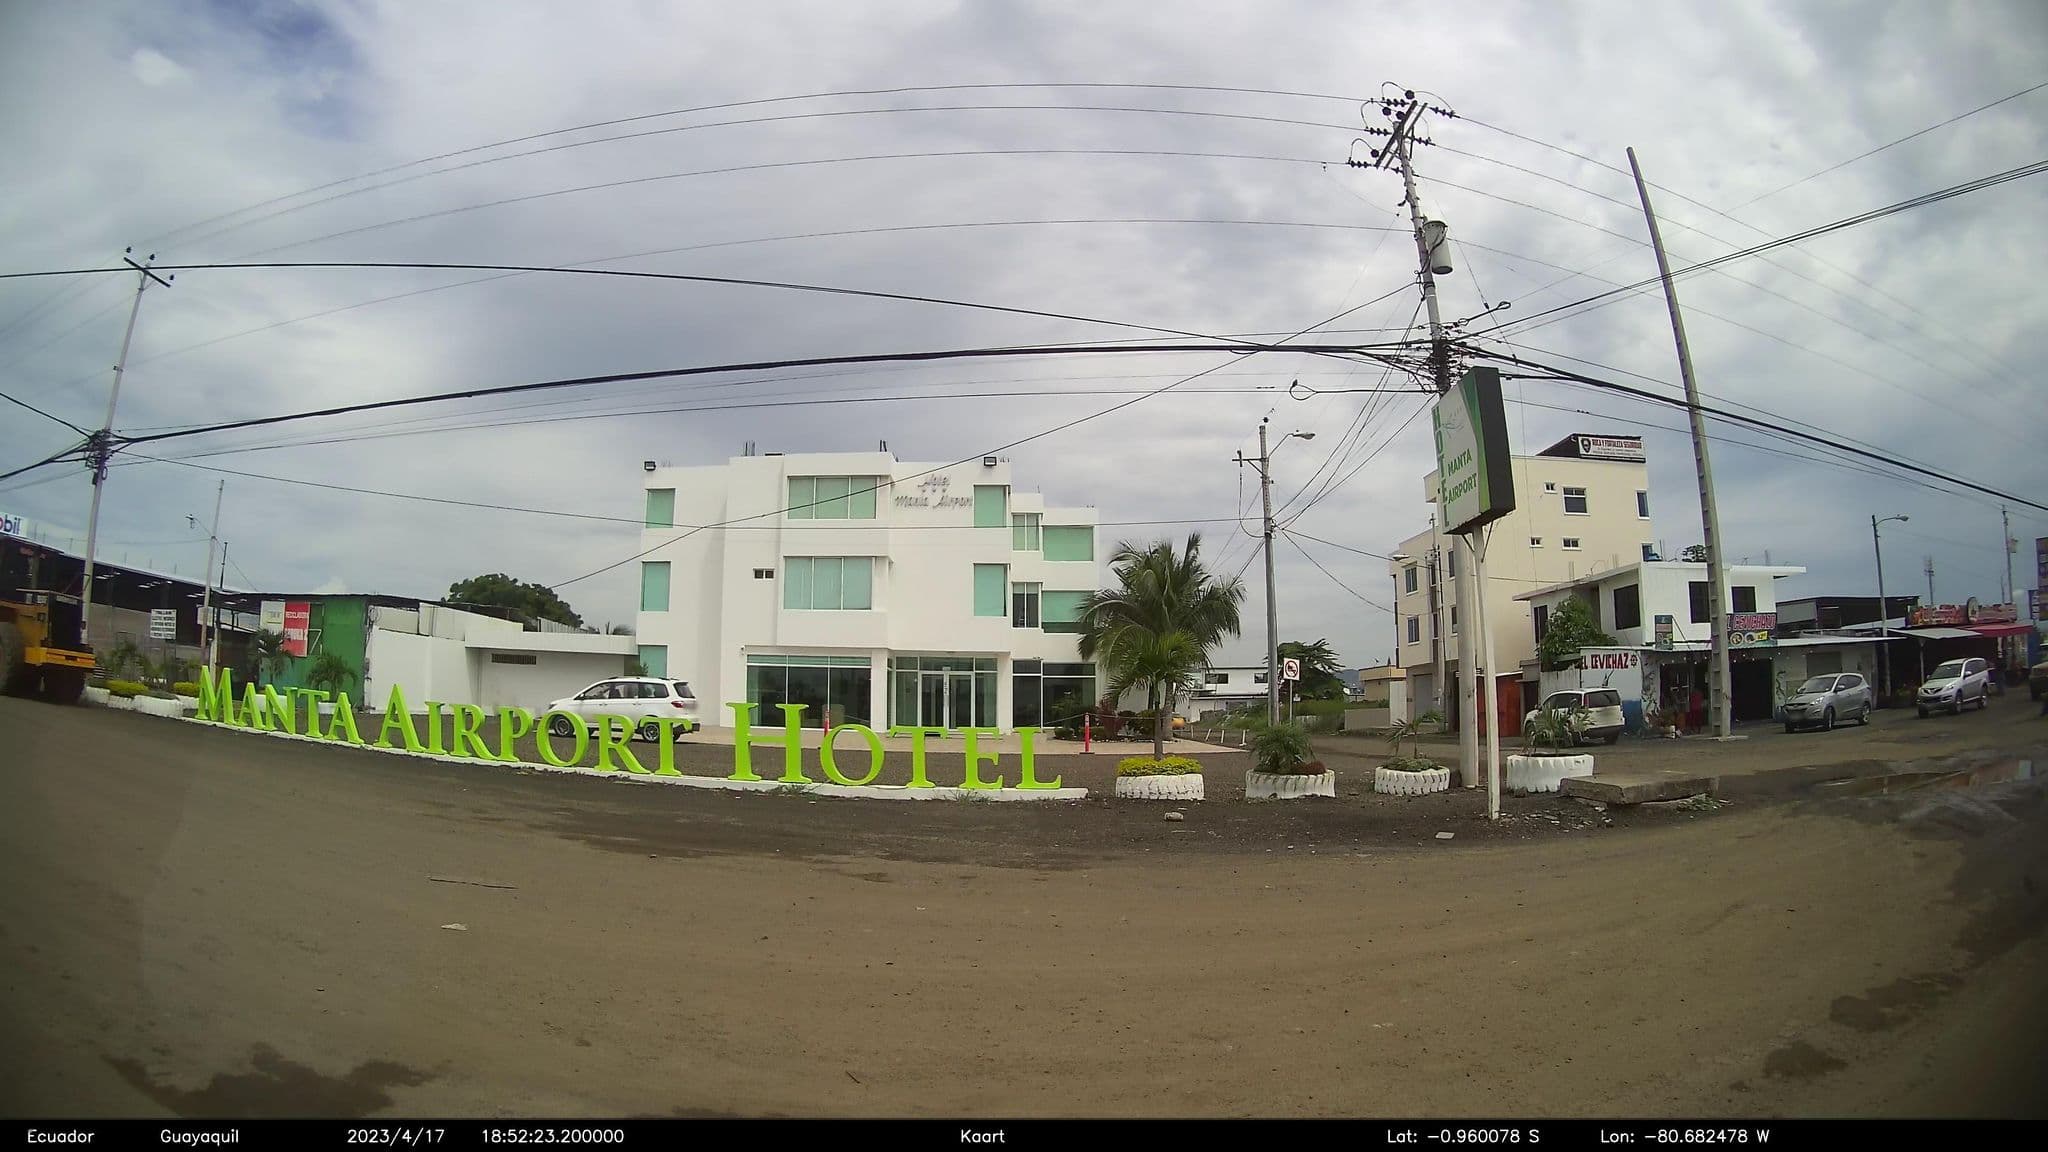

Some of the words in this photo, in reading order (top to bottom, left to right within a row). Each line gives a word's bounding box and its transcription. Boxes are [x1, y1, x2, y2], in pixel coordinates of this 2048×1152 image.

[1447, 448, 1473, 475] MANTA
[895, 495, 929, 508] Manta
[932, 494, 974, 510] Airport
[1448, 473, 1477, 504] AIRPORT
[195, 665, 365, 745] MANTA
[374, 683, 692, 777] AIRPORT
[726, 702, 1063, 790] HOTEL
